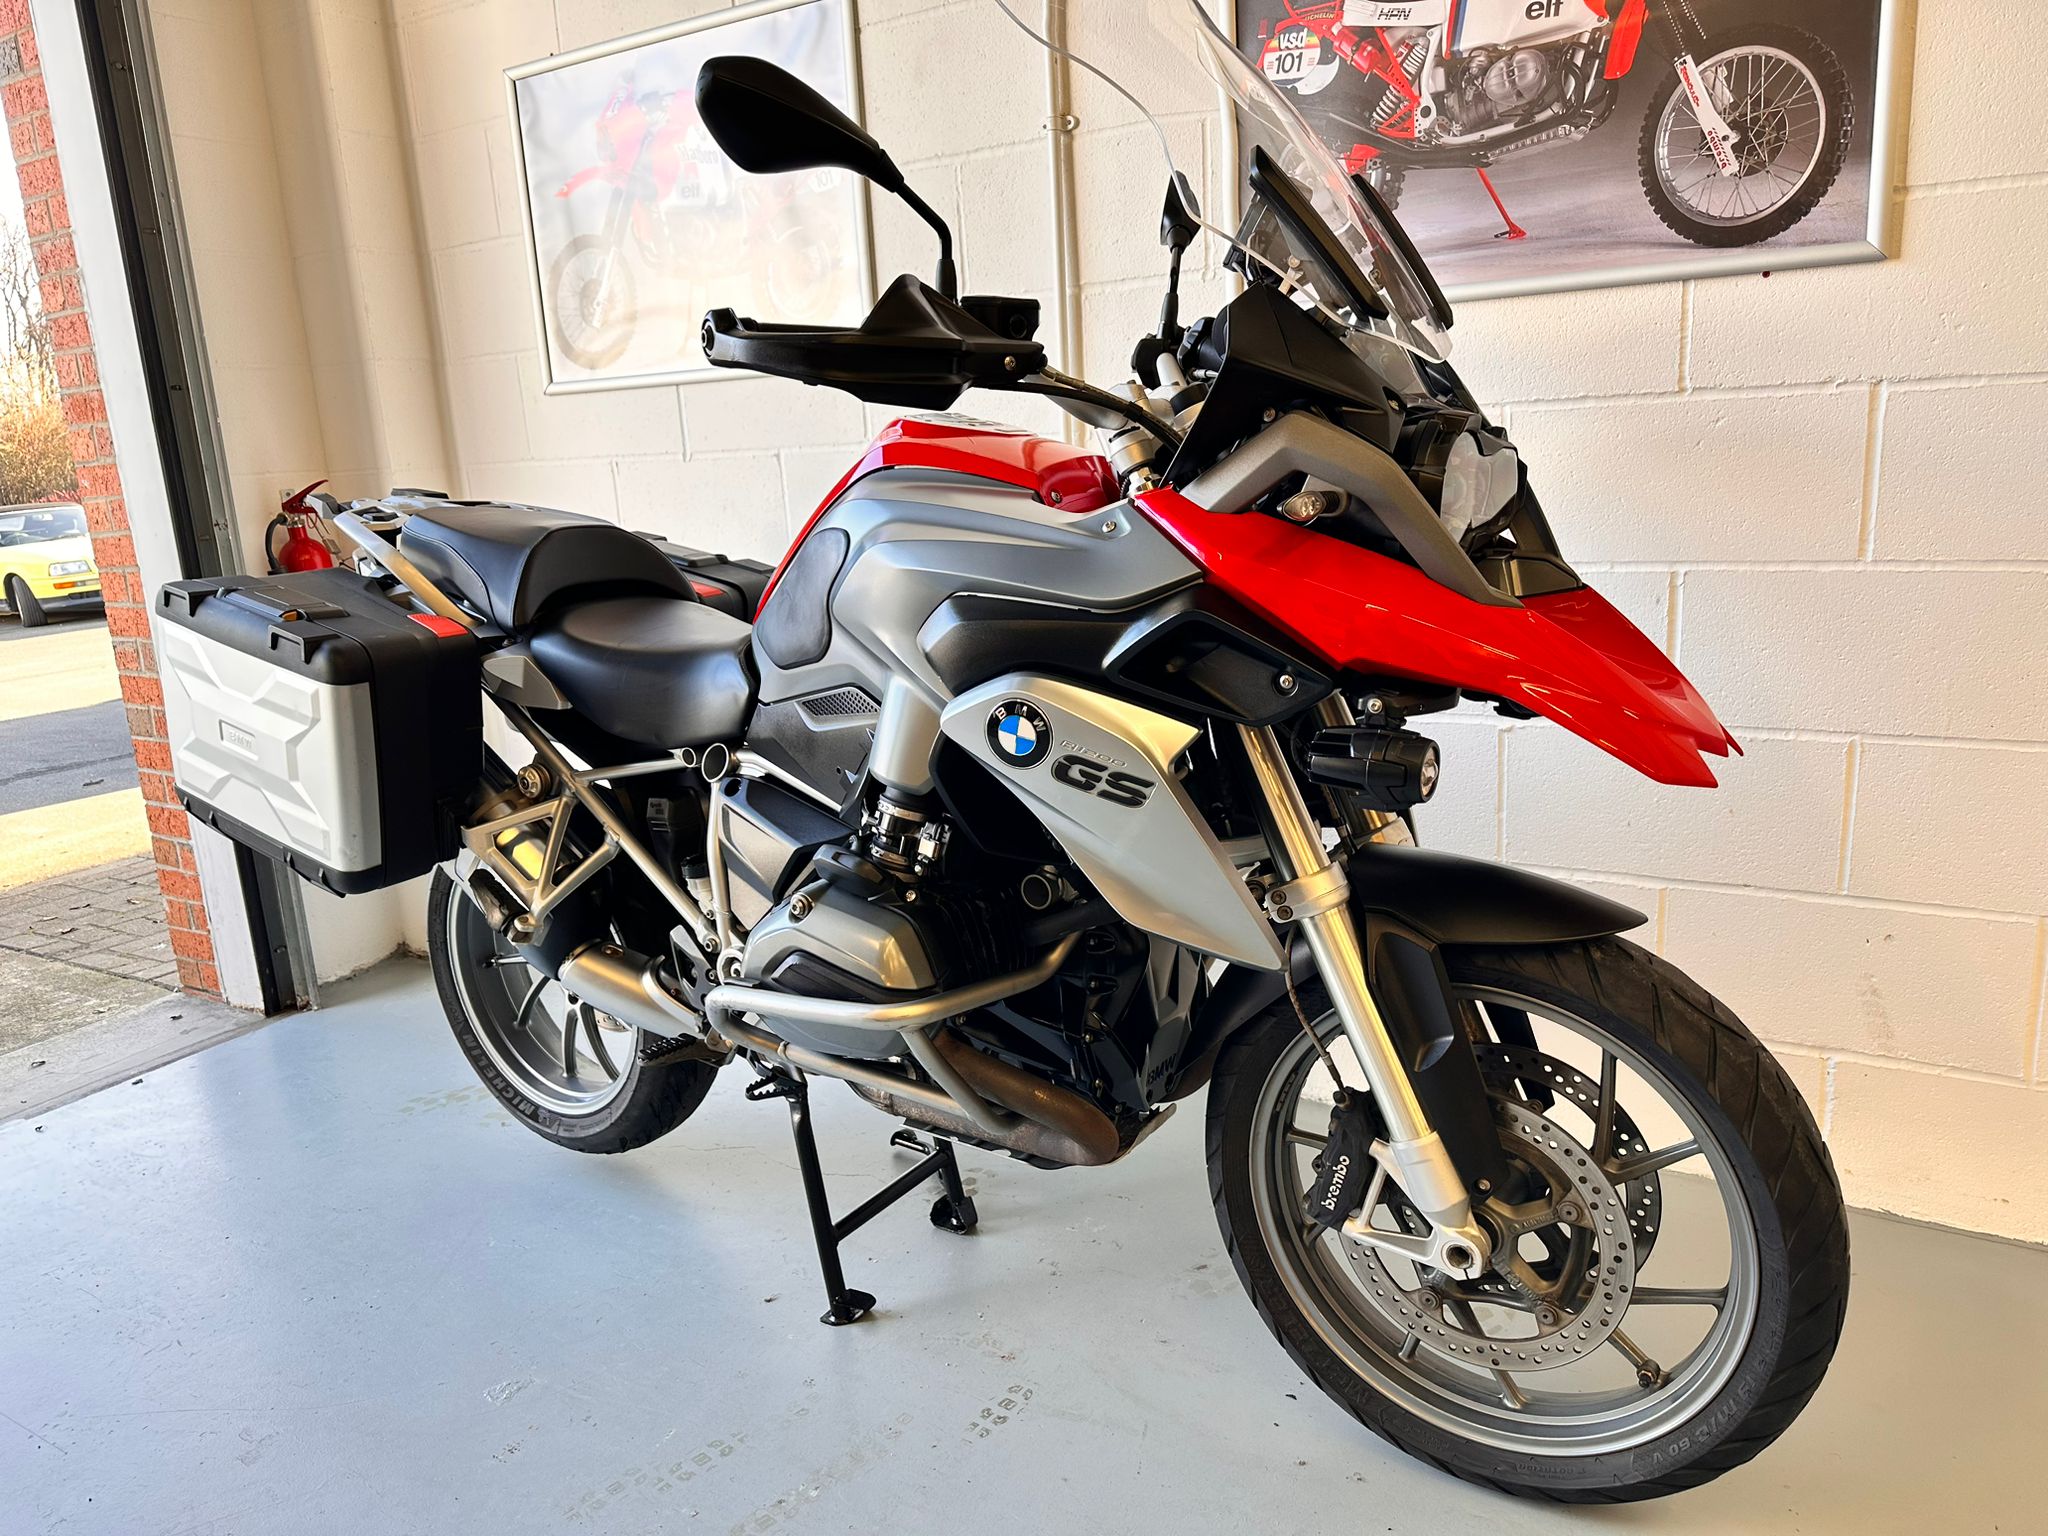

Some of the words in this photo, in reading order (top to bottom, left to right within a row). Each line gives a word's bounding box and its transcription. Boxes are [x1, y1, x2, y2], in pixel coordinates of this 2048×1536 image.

[1377, 8, 1412, 20] HPN
[1525, 0, 1564, 20] elf
[1275, 52, 1304, 75] 101
[1707, 130, 1727, 169] brembo
[994, 703, 1047, 731] BMW
[1051, 754, 1158, 808] GS
[463, 1034, 535, 1115] MICHELIN
[1321, 1155, 1350, 1211] brembo
